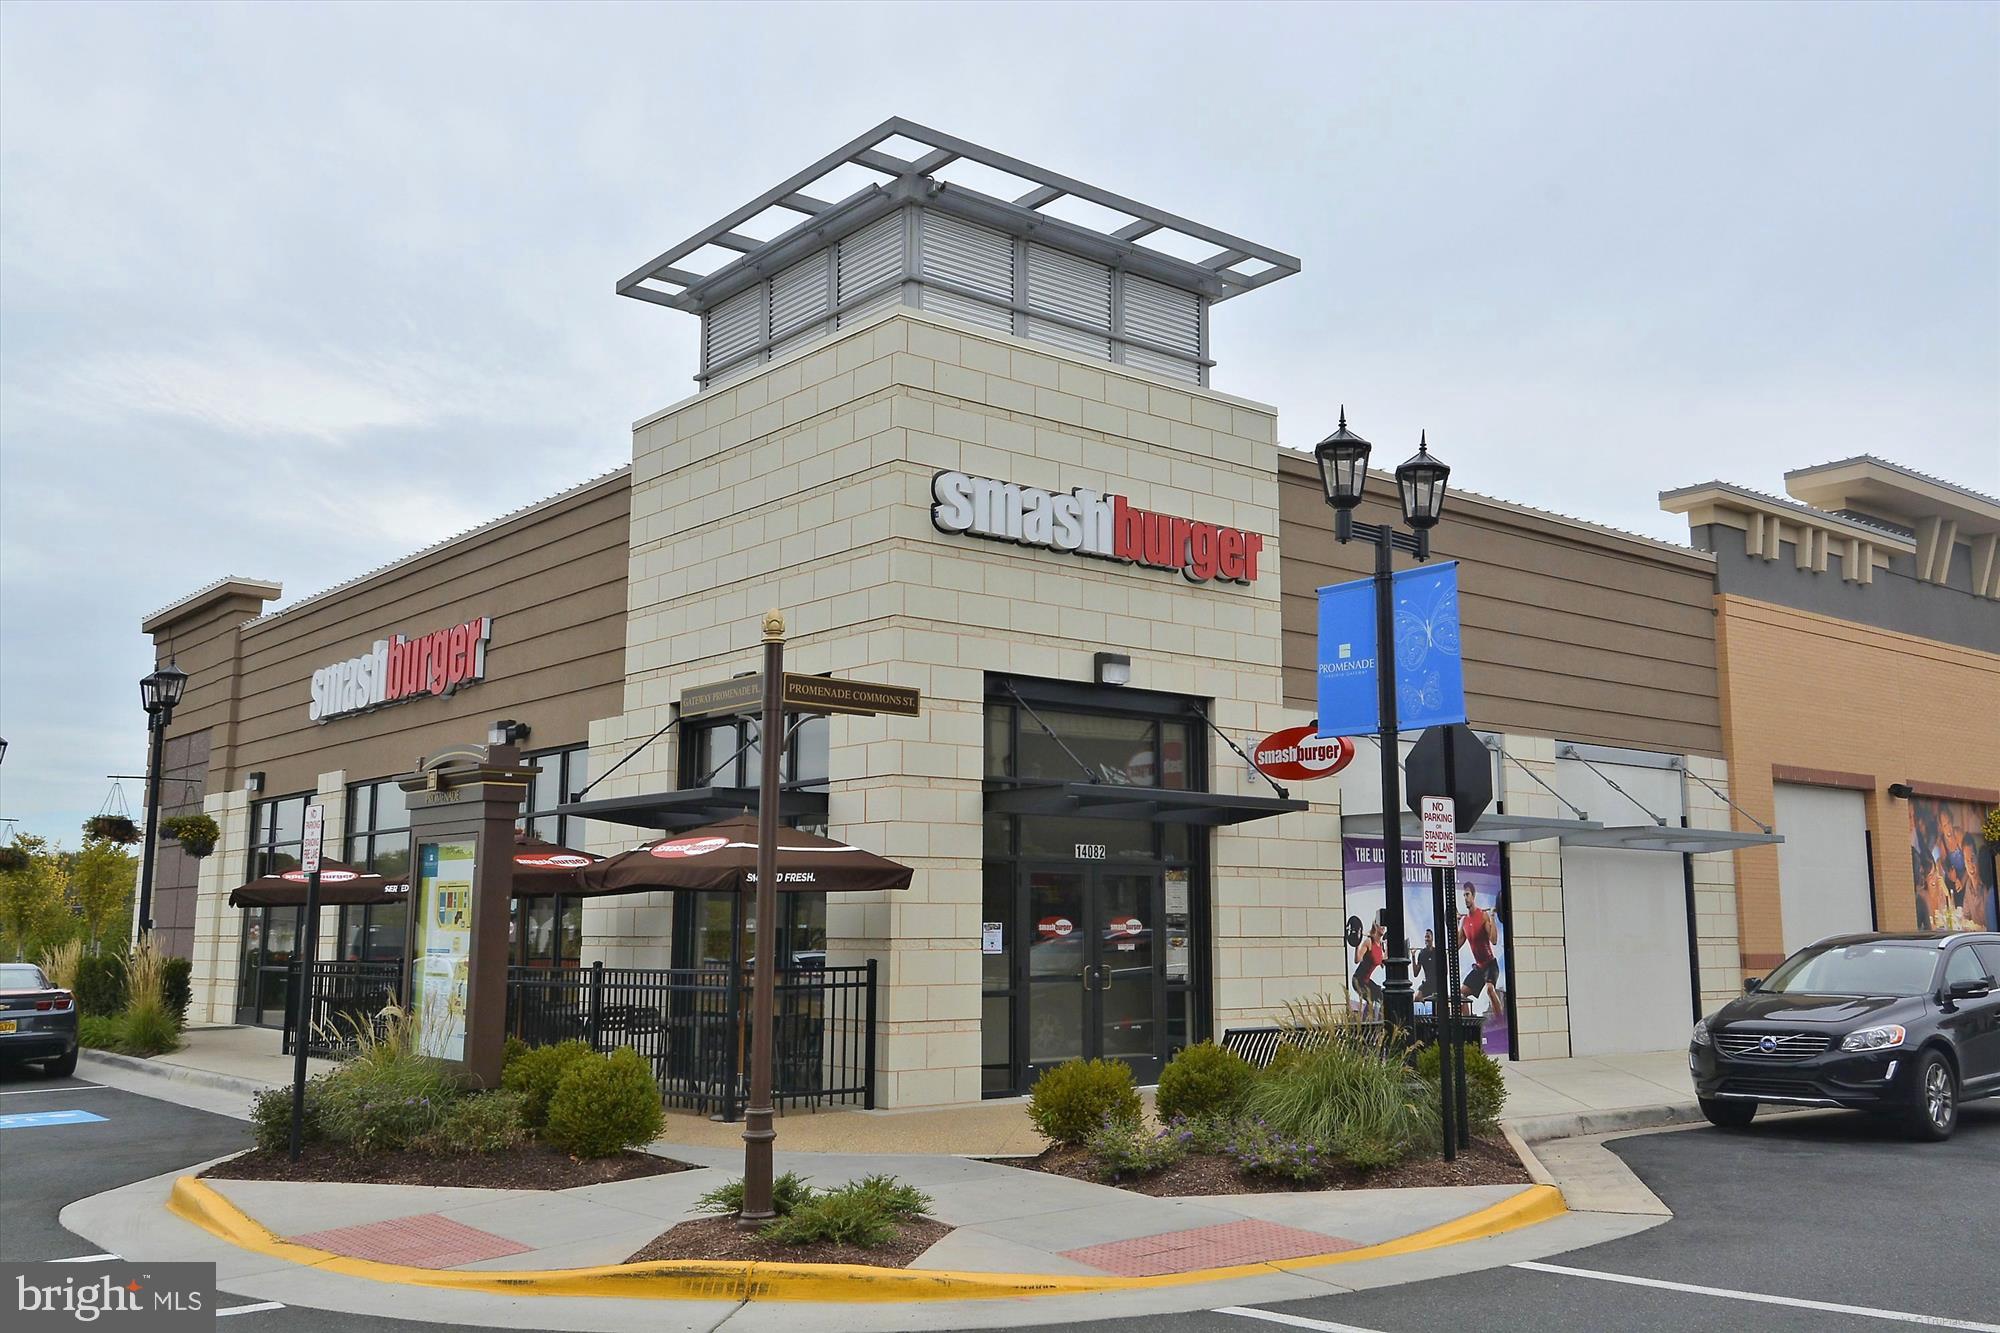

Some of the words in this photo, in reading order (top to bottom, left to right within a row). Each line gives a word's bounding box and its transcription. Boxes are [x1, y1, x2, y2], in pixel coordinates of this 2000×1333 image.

[931, 470, 1263, 582] smashburger
[309, 617, 492, 721] smashburger
[1319, 659, 1375, 674] PROMENADE
[683, 694, 711, 707] GATEWAY
[712, 687, 752, 701] PROMENADE
[789, 683, 850, 699] PROMENADE
[853, 691, 901, 705] COMMONS
[902, 697, 915, 707] ST.
[1258, 744, 1340, 765] smashburger
[1432, 802, 1443, 811] NO
[1424, 813, 1452, 823] PARKING
[1425, 830, 1453, 840] STANDING
[1076, 845, 1105, 859] 14082
[1425, 842, 1437, 852] FIRE
[1439, 842, 1453, 853] LANE
[1355, 847, 1371, 862] THE
[1373, 848, 1409, 864] ULTTE
[784, 872, 816, 882] FRESH.
[1405, 866, 1433, 883] ULTIMA
[384, 884, 410, 893] SERED
